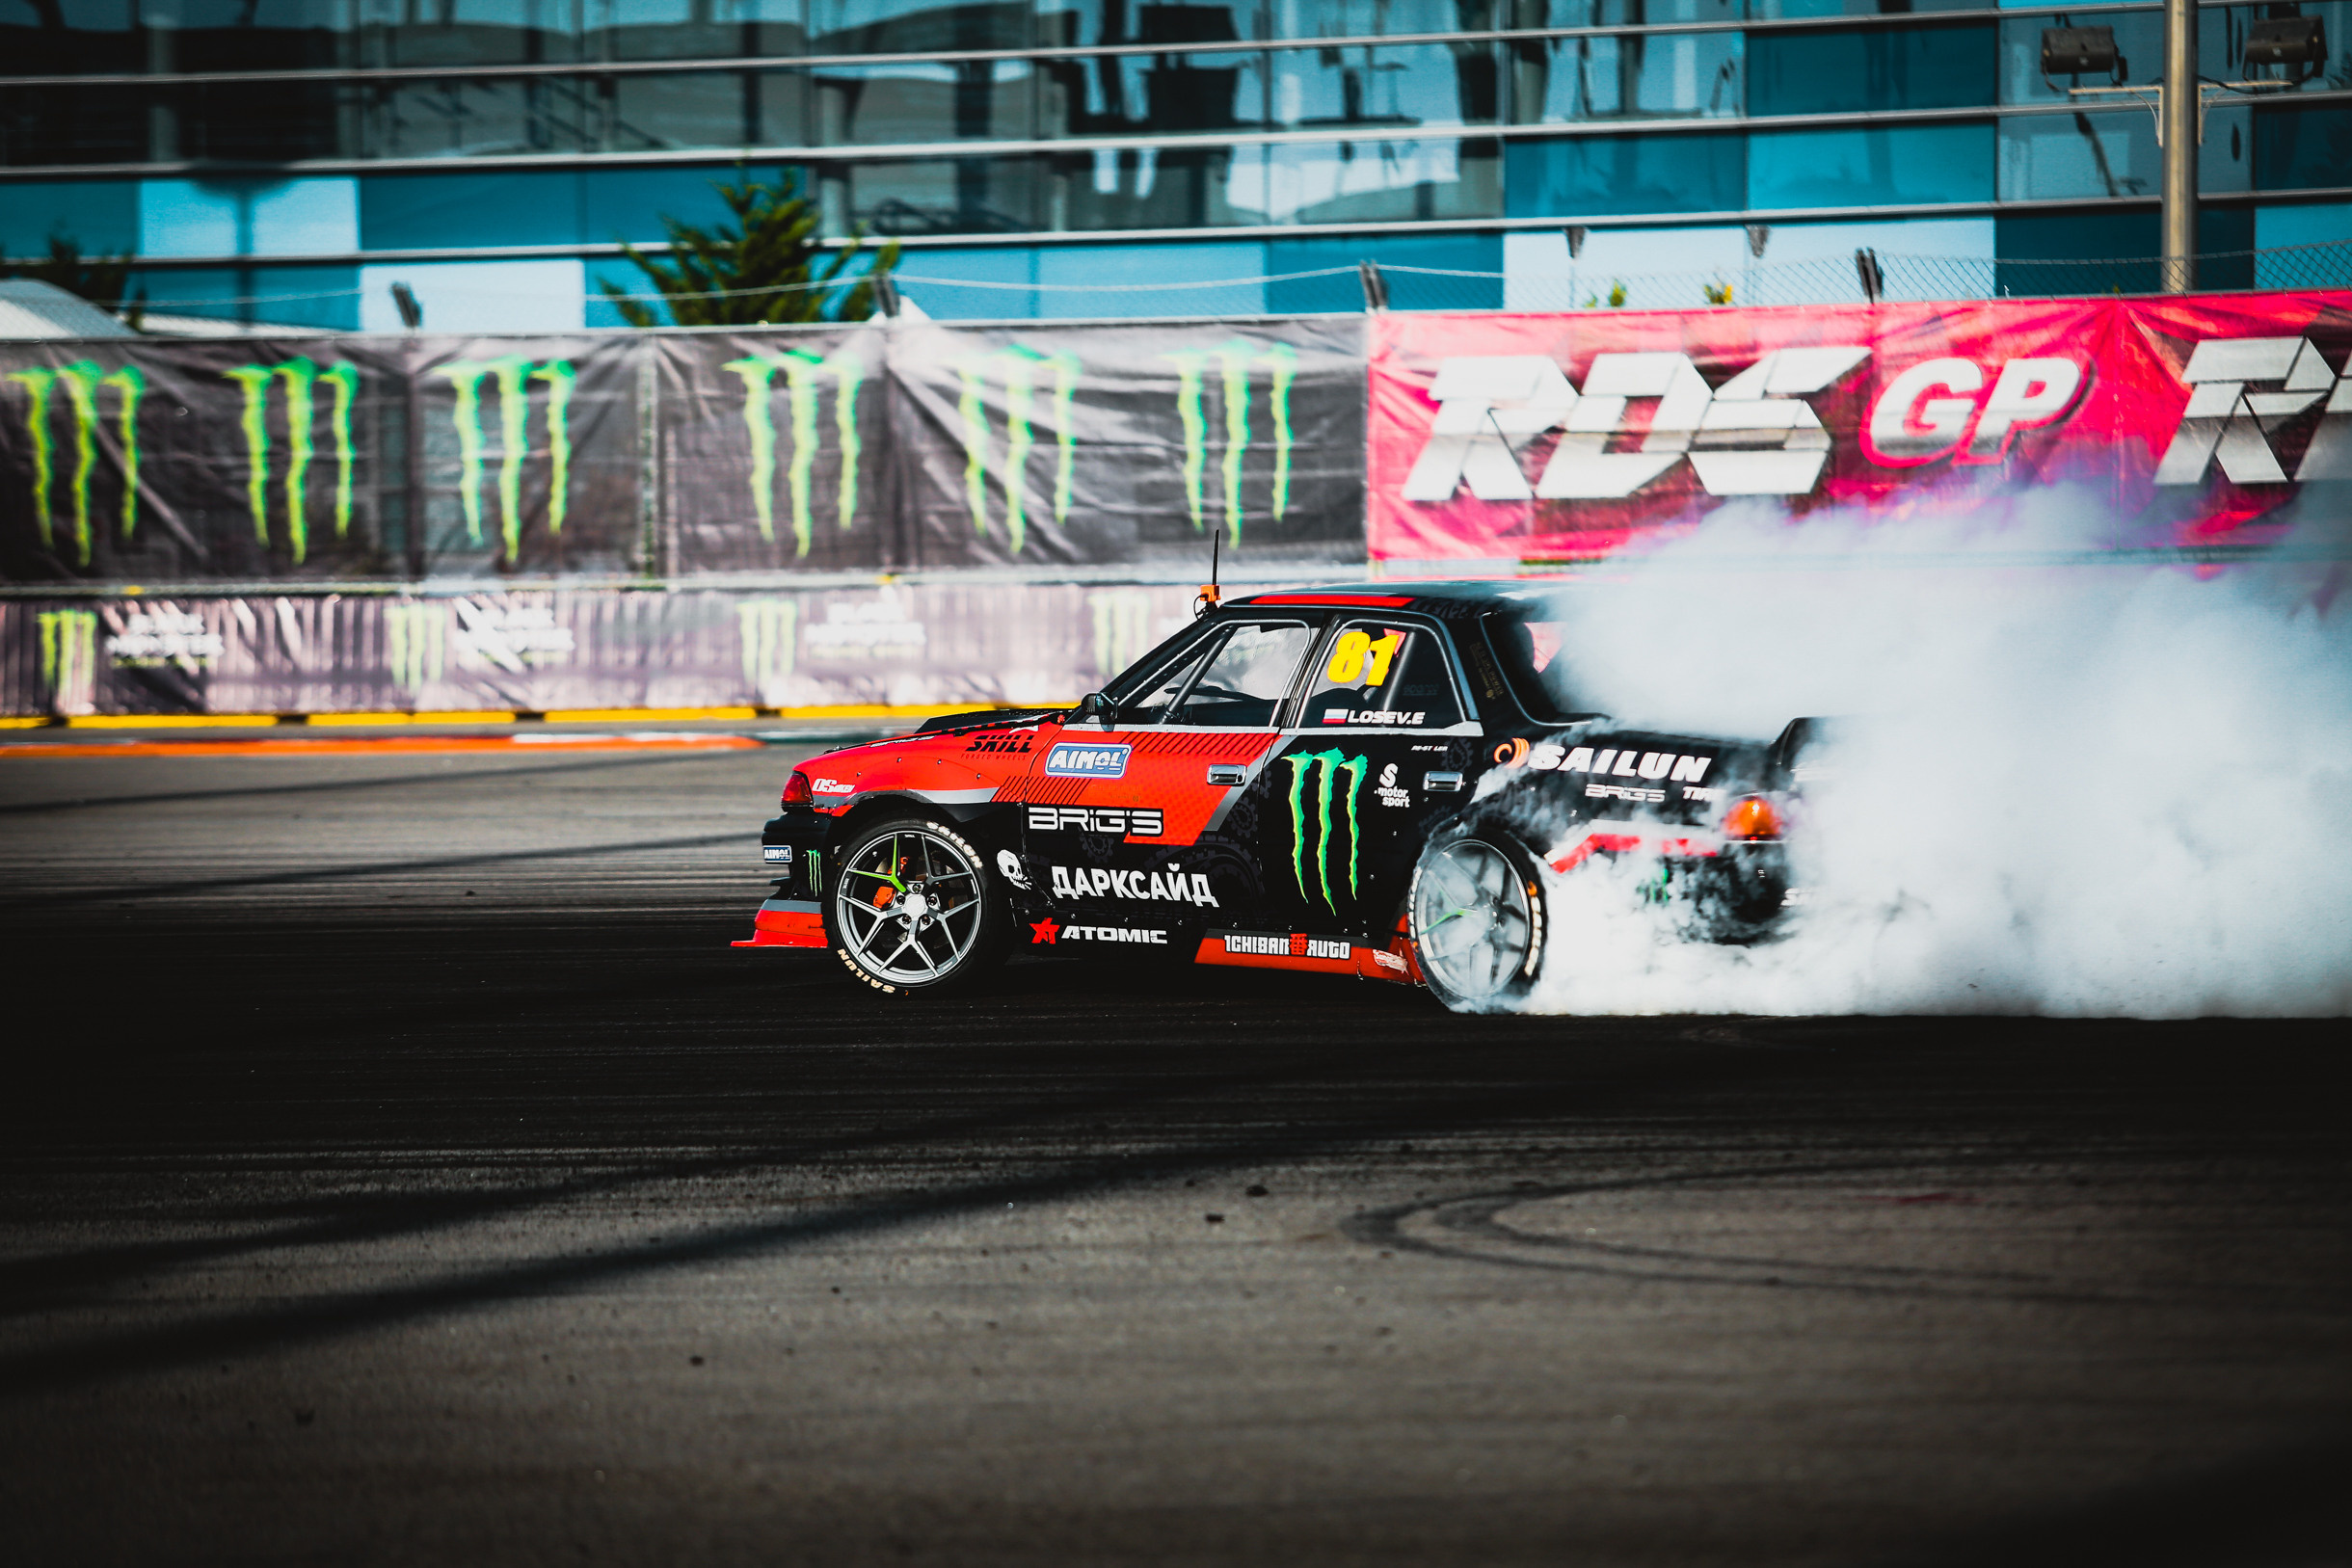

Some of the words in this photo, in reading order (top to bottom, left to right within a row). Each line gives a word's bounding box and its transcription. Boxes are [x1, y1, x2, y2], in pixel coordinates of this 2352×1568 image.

[1403, 346, 1872, 500] RDS
[1865, 356, 2084, 465] GP
[2153, 335, 2352, 484] R
[1327, 631, 1400, 686] 81
[1348, 709, 1426, 725] LOSEV.E
[965, 735, 1034, 753] SKILL
[1048, 749, 1129, 770] AIMOL
[1527, 744, 1712, 783] SAILUN
[1382, 796, 1410, 808] sport
[1052, 863, 1219, 908] ДАРКСАЙД
[1061, 925, 1167, 944] ATOMIC
[1306, 940, 1350, 960] AUTO
[838, 948, 895, 994] SAILUN
